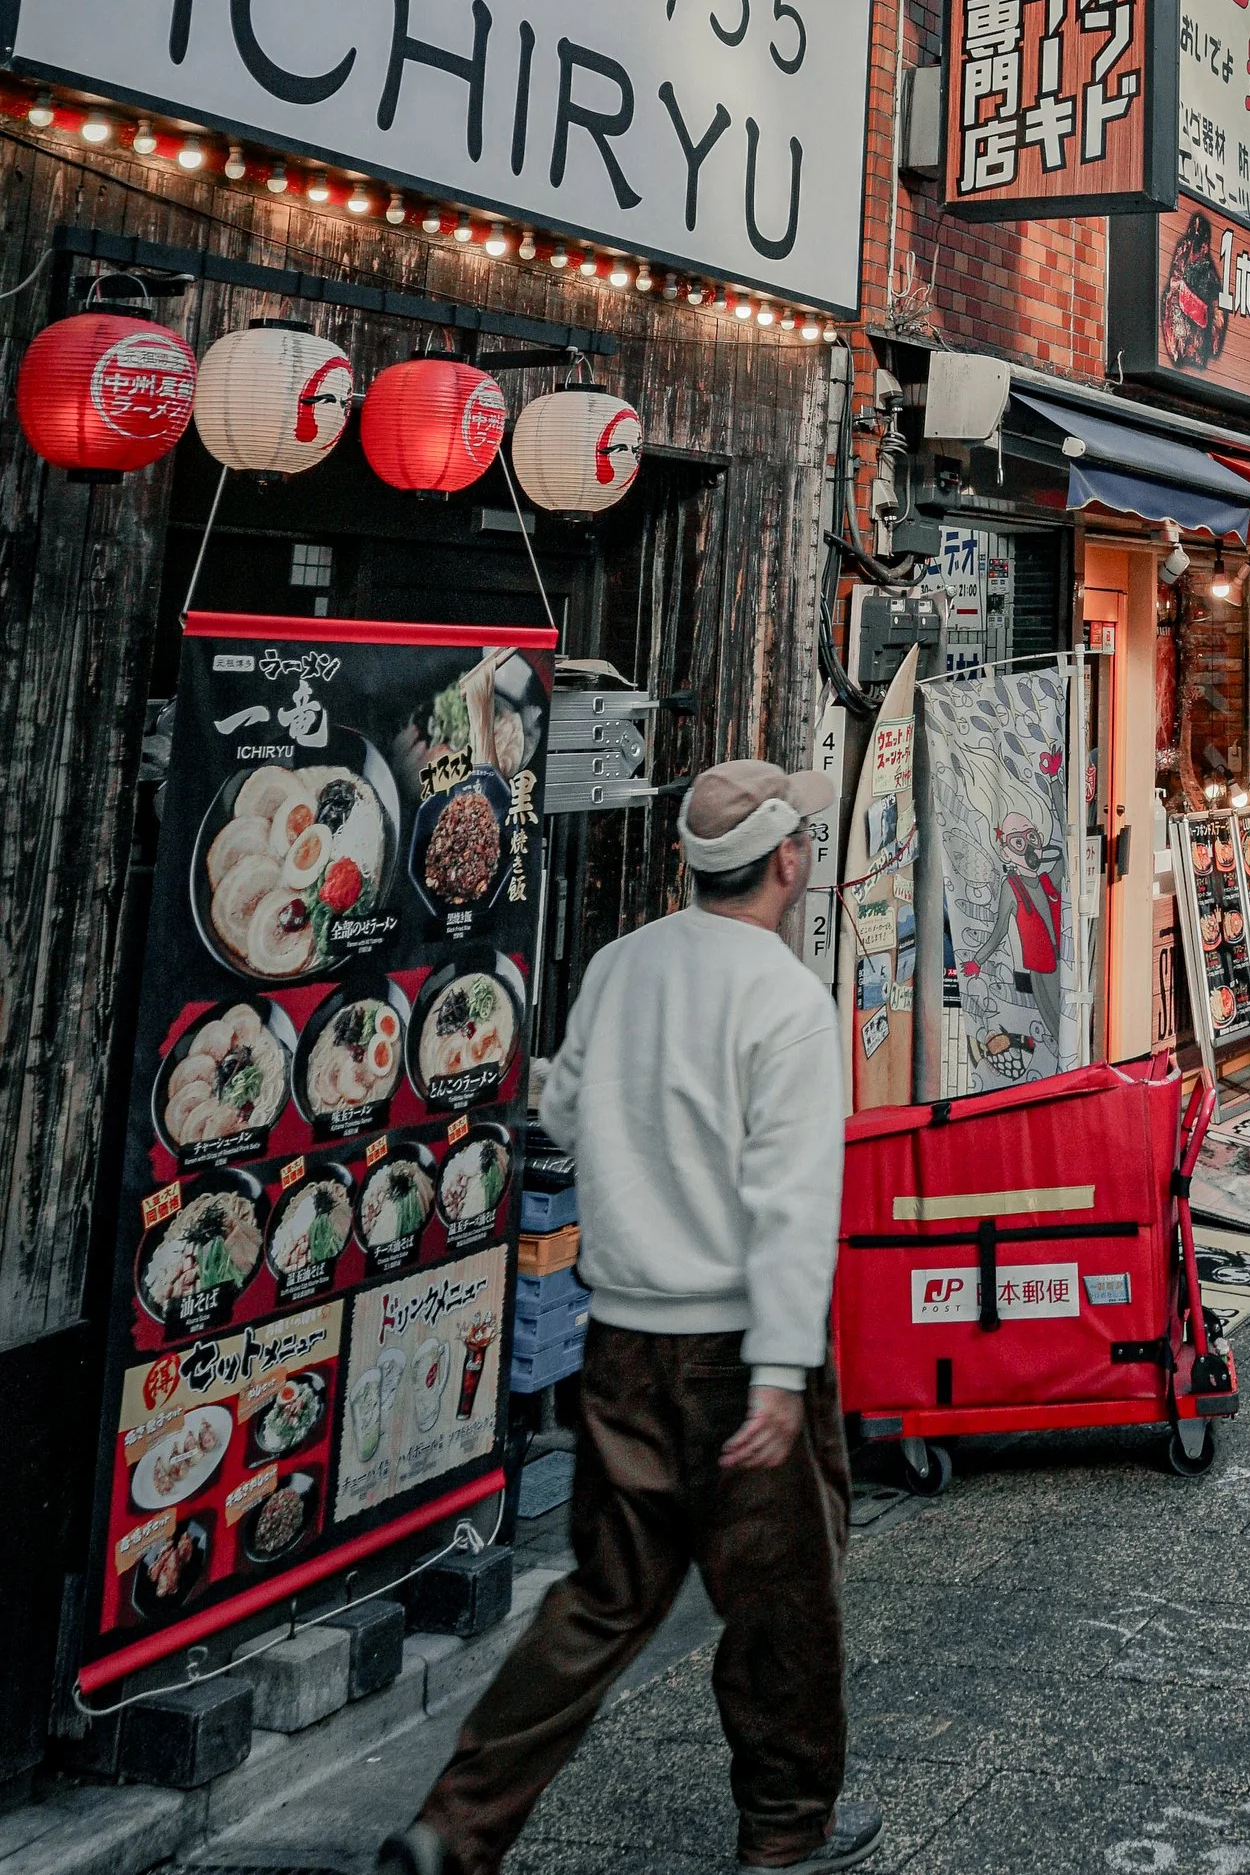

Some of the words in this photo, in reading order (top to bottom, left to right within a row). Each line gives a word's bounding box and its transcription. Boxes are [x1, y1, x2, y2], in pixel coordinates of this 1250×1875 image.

[958, 582, 977, 598] 21:00
[258, 648, 341, 682] ラーメン
[236, 745, 295, 760] ICHIRYU
[822, 731, 835, 770] 4F
[419, 745, 474, 800] オススメ
[505, 770, 539, 902] 黒焼き飯
[330, 916, 398, 941] 全部のせラーメン
[813, 916, 826, 956] 2F
[428, 1069, 498, 1098] とんこつラーメン
[194, 1132, 253, 1155] チャーシューメン
[179, 1289, 219, 1320] 油そば
[976, 1278, 1070, 1306] 本郵便
[378, 1278, 488, 1345] ドリンクメニュー
[922, 1305, 961, 1313] POST
[179, 1327, 326, 1393] セットメニュー
